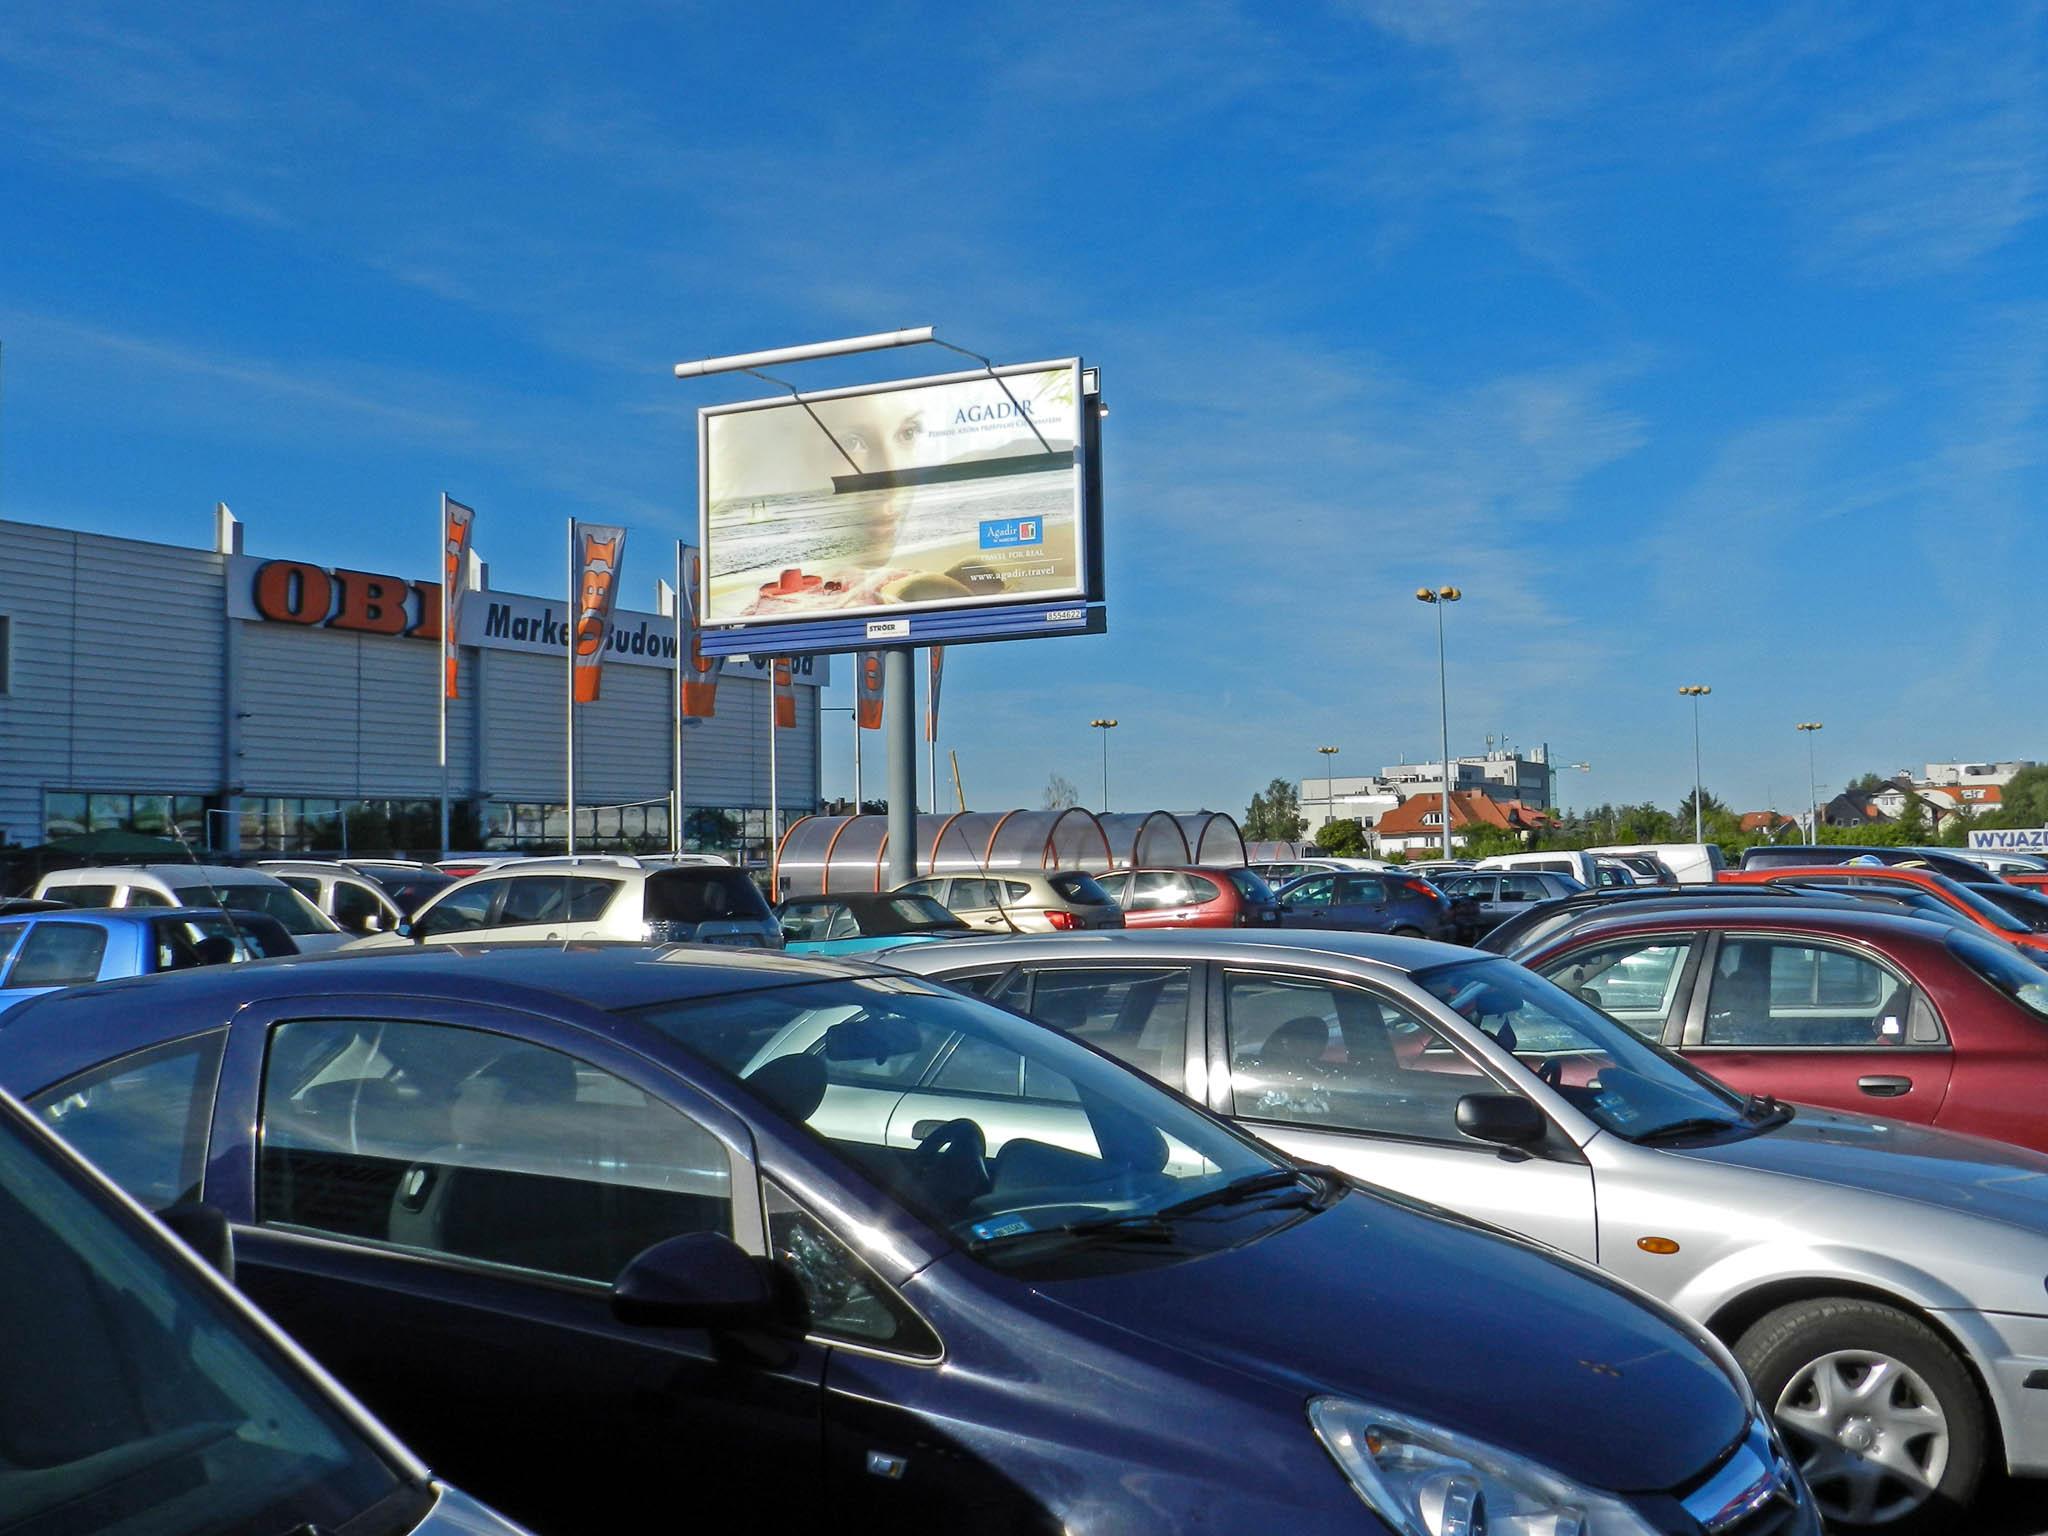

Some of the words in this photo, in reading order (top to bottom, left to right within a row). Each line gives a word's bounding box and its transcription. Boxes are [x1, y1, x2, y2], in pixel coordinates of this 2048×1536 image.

[954, 399, 1035, 424] AGADIR
[987, 523, 1018, 540] Agadir
[970, 565, 1055, 582] www.agadir.travel
[252, 558, 443, 641] OBI
[485, 602, 569, 647] Marke
